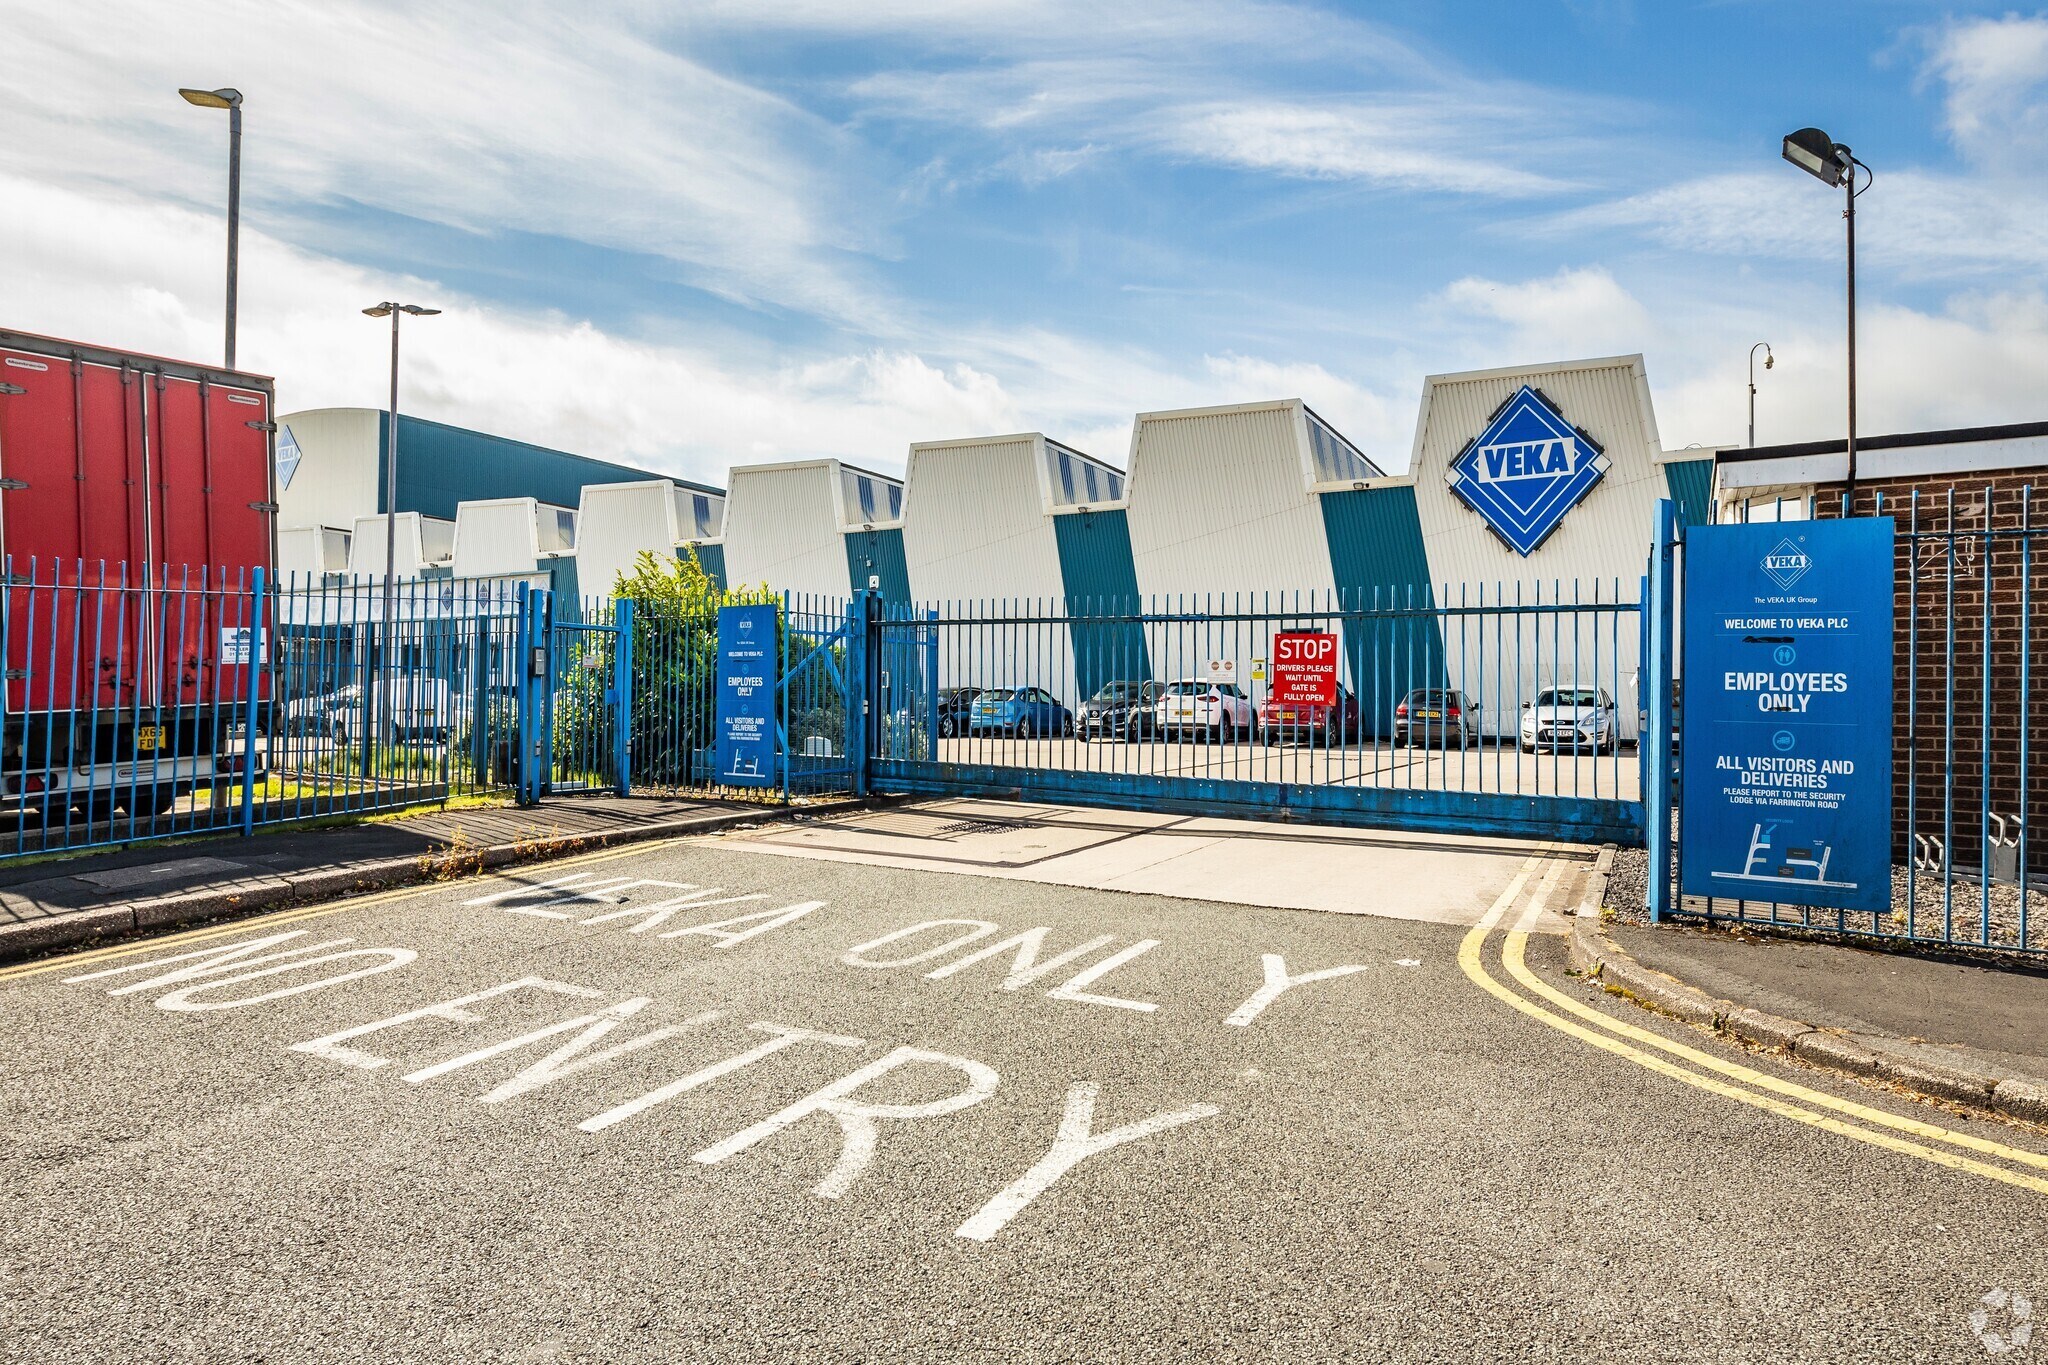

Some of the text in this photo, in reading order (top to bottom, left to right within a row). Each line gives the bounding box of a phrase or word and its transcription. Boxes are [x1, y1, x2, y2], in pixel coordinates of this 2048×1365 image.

[1483, 441, 1569, 479] VEKA
[1769, 556, 1803, 568] VEKA
[1797, 597, 1818, 605] Group
[1724, 618, 1849, 629] WELCOME TO VEKA PLC
[1279, 639, 1333, 660] STOP
[1276, 664, 1334, 673] DRIVERS PLEASE
[727, 676, 764, 687] EMPLOYEES
[1285, 674, 1324, 682] WAIT UNTIL
[1724, 671, 1848, 693] EMPLOYEES
[737, 686, 753, 697] ONLY
[1291, 683, 1317, 692] GATE IS
[1283, 693, 1325, 702] FULLY OPEN
[1758, 692, 1812, 713] ONLY
[725, 716, 765, 725] ALL VISITORS AND
[732, 724, 758, 732] DELIVERIES
[1715, 755, 1855, 775] ALL VISITORS AND
[1740, 771, 1829, 789] DELIVERIES
[1723, 787, 1847, 801] PLEASE REPORT TO THE SECURITY
[1729, 795, 1839, 809] LODGE VIA FARRINGTON ROAD
[462, 872, 1364, 1028] VEKA ONLY
[62, 930, 1222, 1241] NO ENTRY
